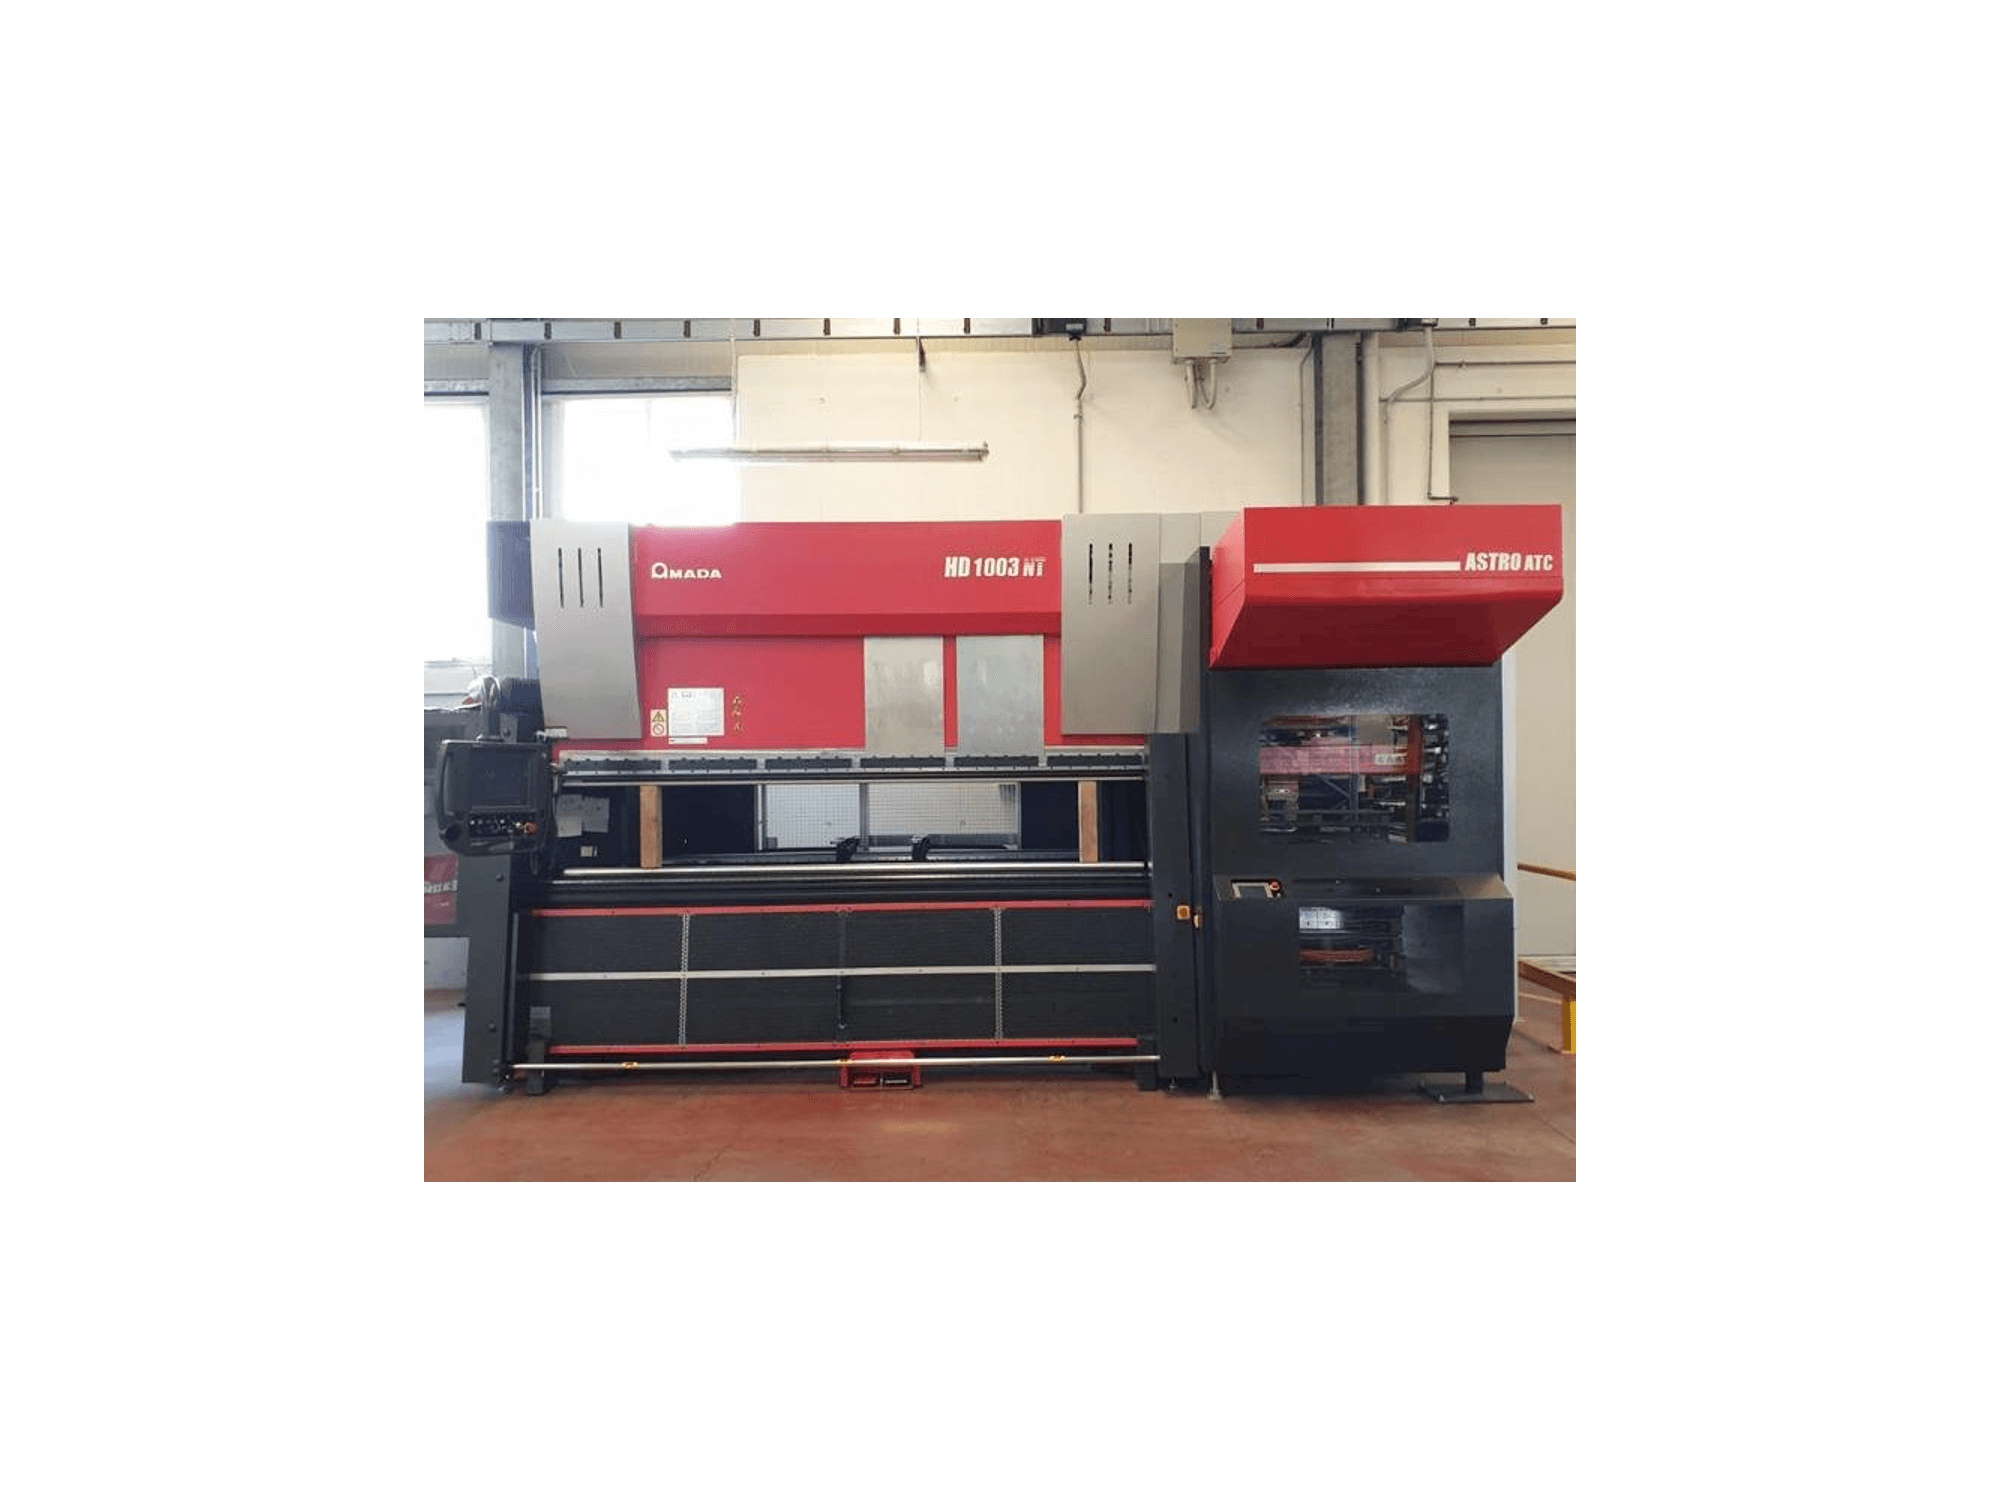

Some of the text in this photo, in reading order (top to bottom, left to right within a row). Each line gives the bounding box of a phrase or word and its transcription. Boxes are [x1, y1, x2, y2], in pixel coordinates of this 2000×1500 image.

[651, 561, 722, 579] AMADA
[944, 556, 1046, 577] HD 1003 NT
[1465, 552, 1553, 571] ASTRO ATC
